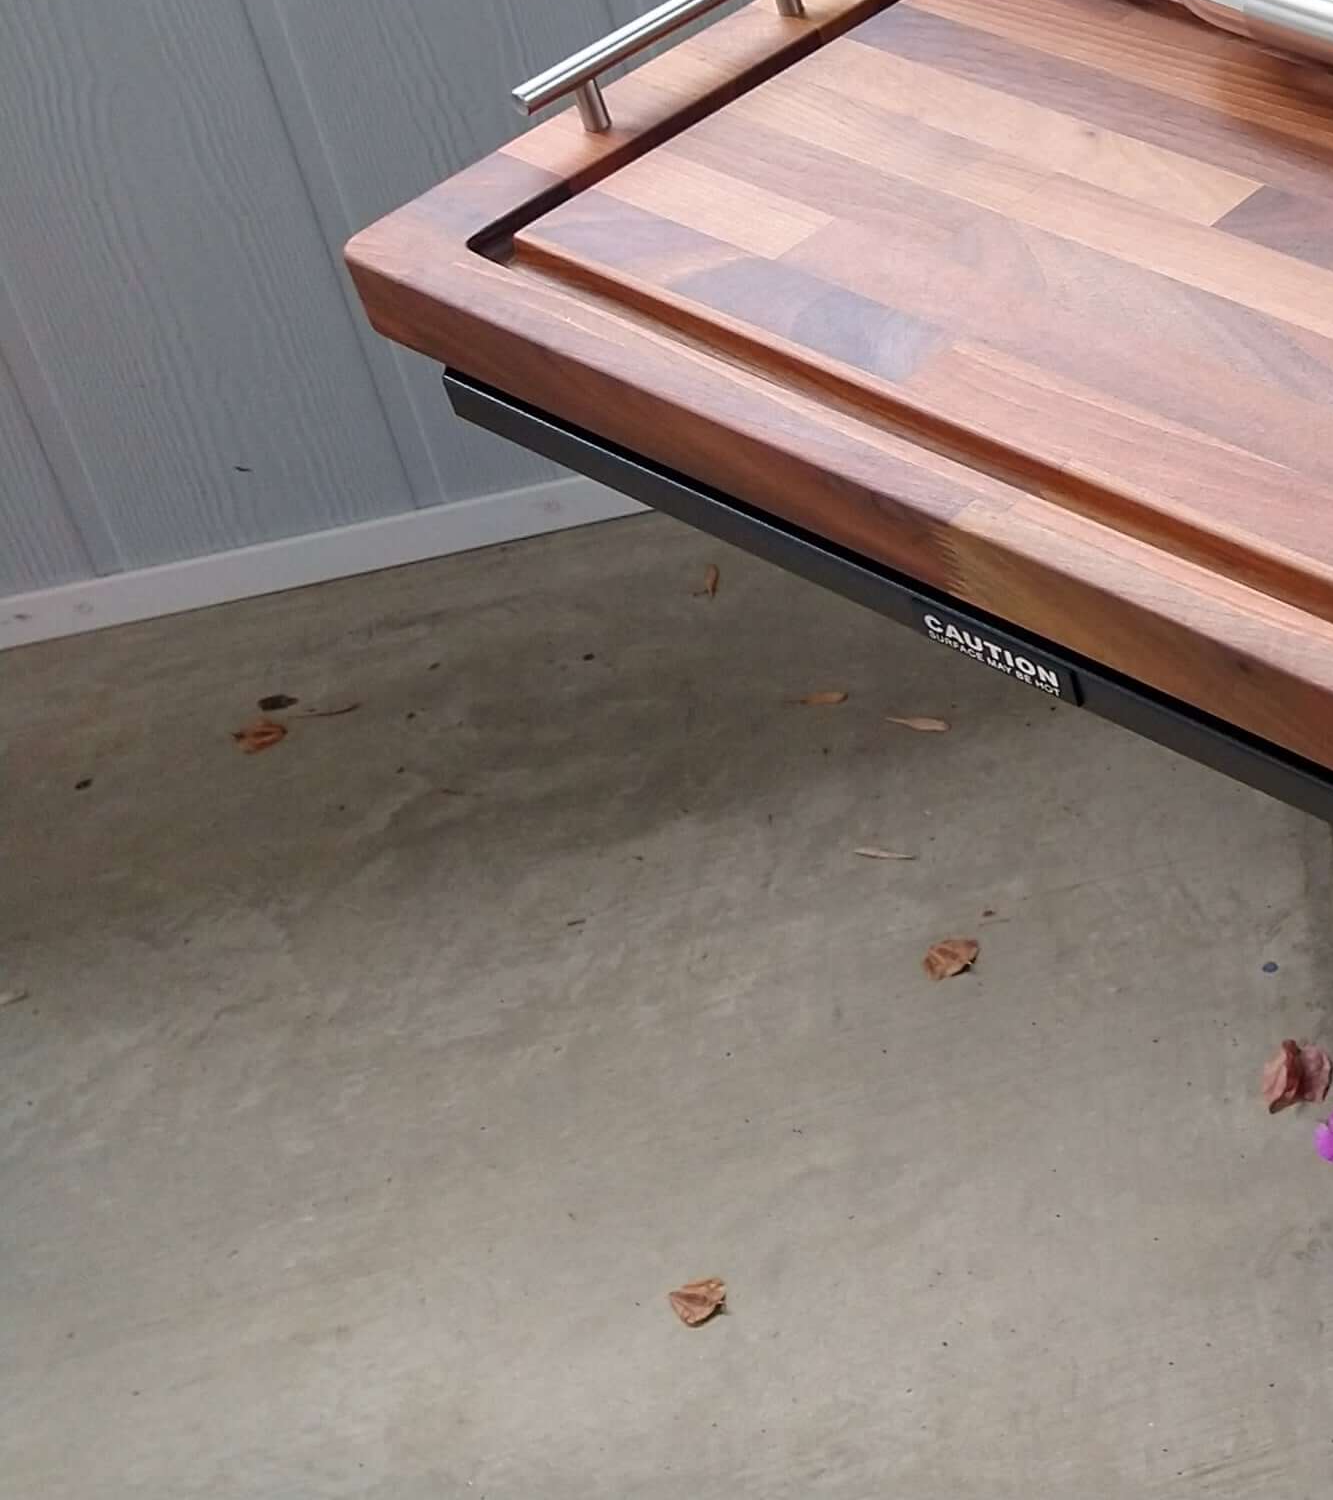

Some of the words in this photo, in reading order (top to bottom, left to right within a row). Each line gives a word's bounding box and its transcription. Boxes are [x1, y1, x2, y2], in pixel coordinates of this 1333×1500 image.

[923, 614, 1060, 688] CAUTION
[928, 630, 986, 663] SURFACE
[986, 656, 1013, 675] MAY
[1015, 671, 1033, 685] BE
[1035, 679, 1062, 697] HOT
